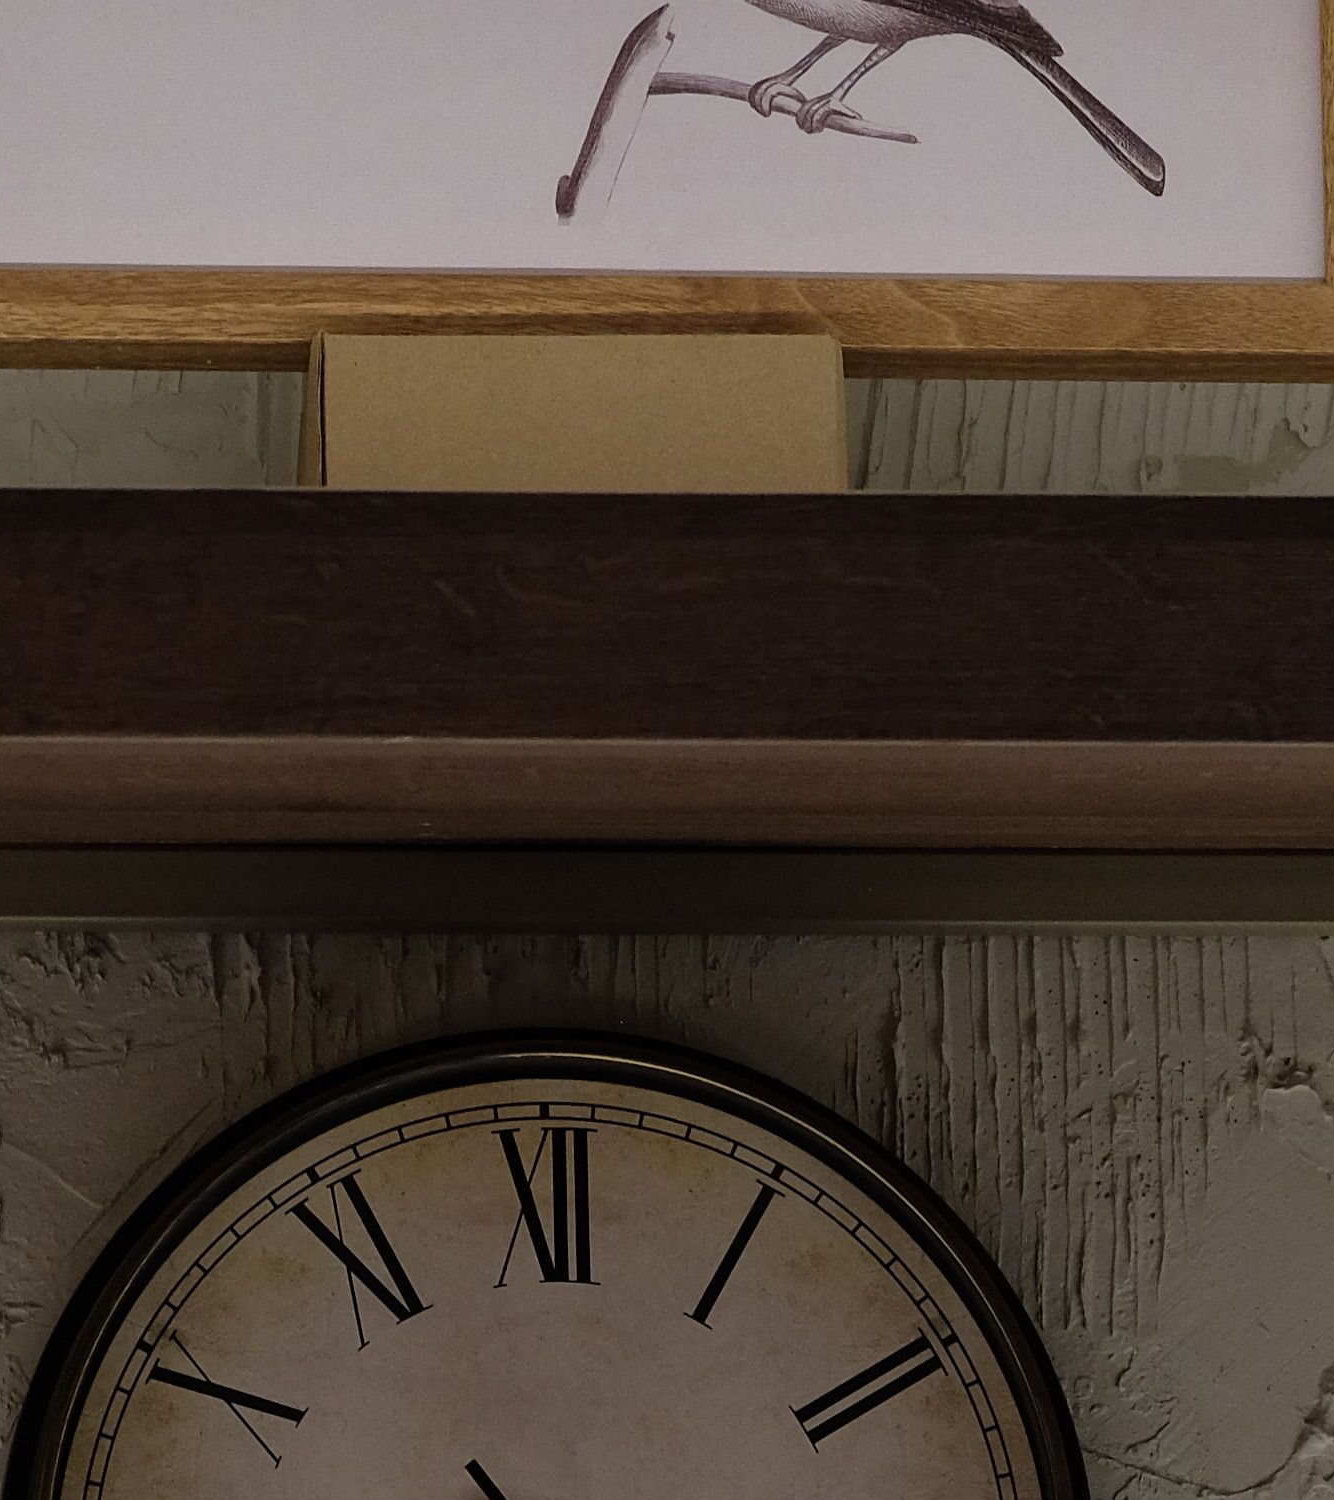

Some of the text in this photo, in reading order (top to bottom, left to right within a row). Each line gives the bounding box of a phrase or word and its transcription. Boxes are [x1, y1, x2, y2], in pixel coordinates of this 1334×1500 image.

[287, 1171, 433, 1350] XI
[493, 1127, 601, 1287] XII
[684, 1180, 782, 1329] I
[145, 1329, 308, 1467] X
[788, 1327, 951, 1454] II
